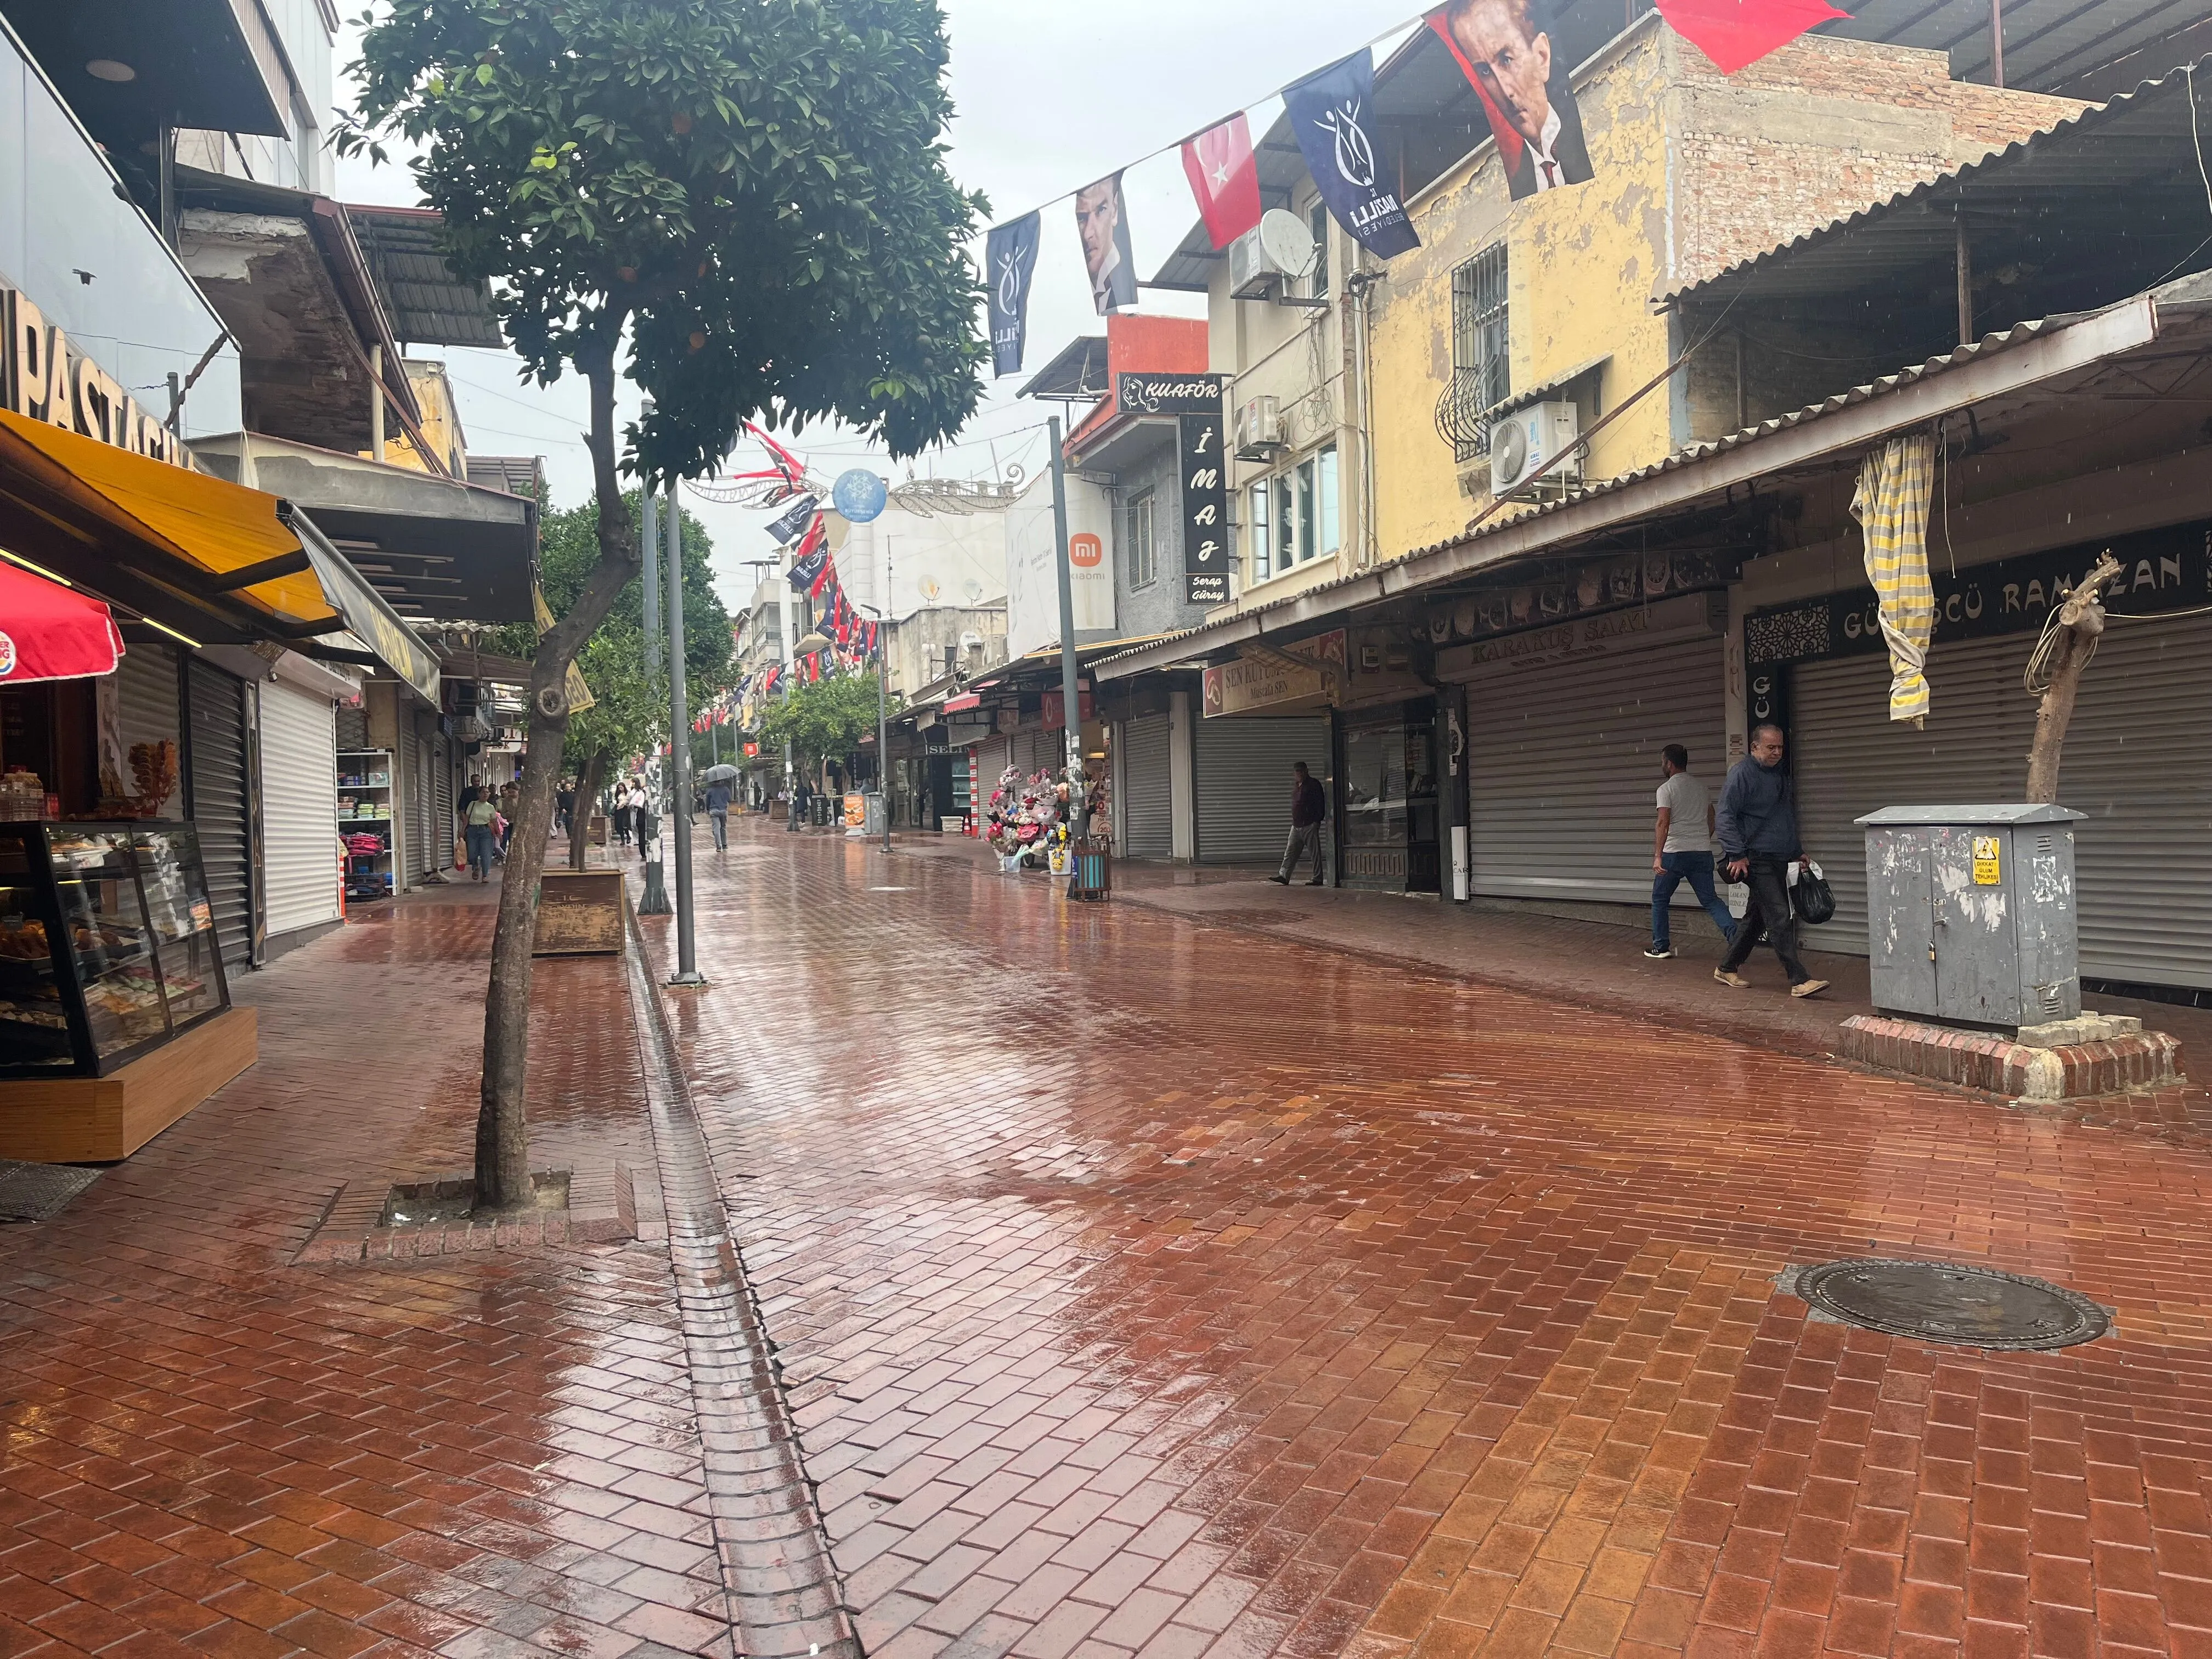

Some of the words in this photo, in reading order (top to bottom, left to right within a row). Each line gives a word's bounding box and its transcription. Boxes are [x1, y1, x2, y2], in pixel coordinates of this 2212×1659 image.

[1145, 379, 1219, 398] KUAFÖR
[1192, 576, 1222, 587] Serap
[1192, 590, 1224, 601] Güray
[1584, 608, 1651, 642] SAAT
